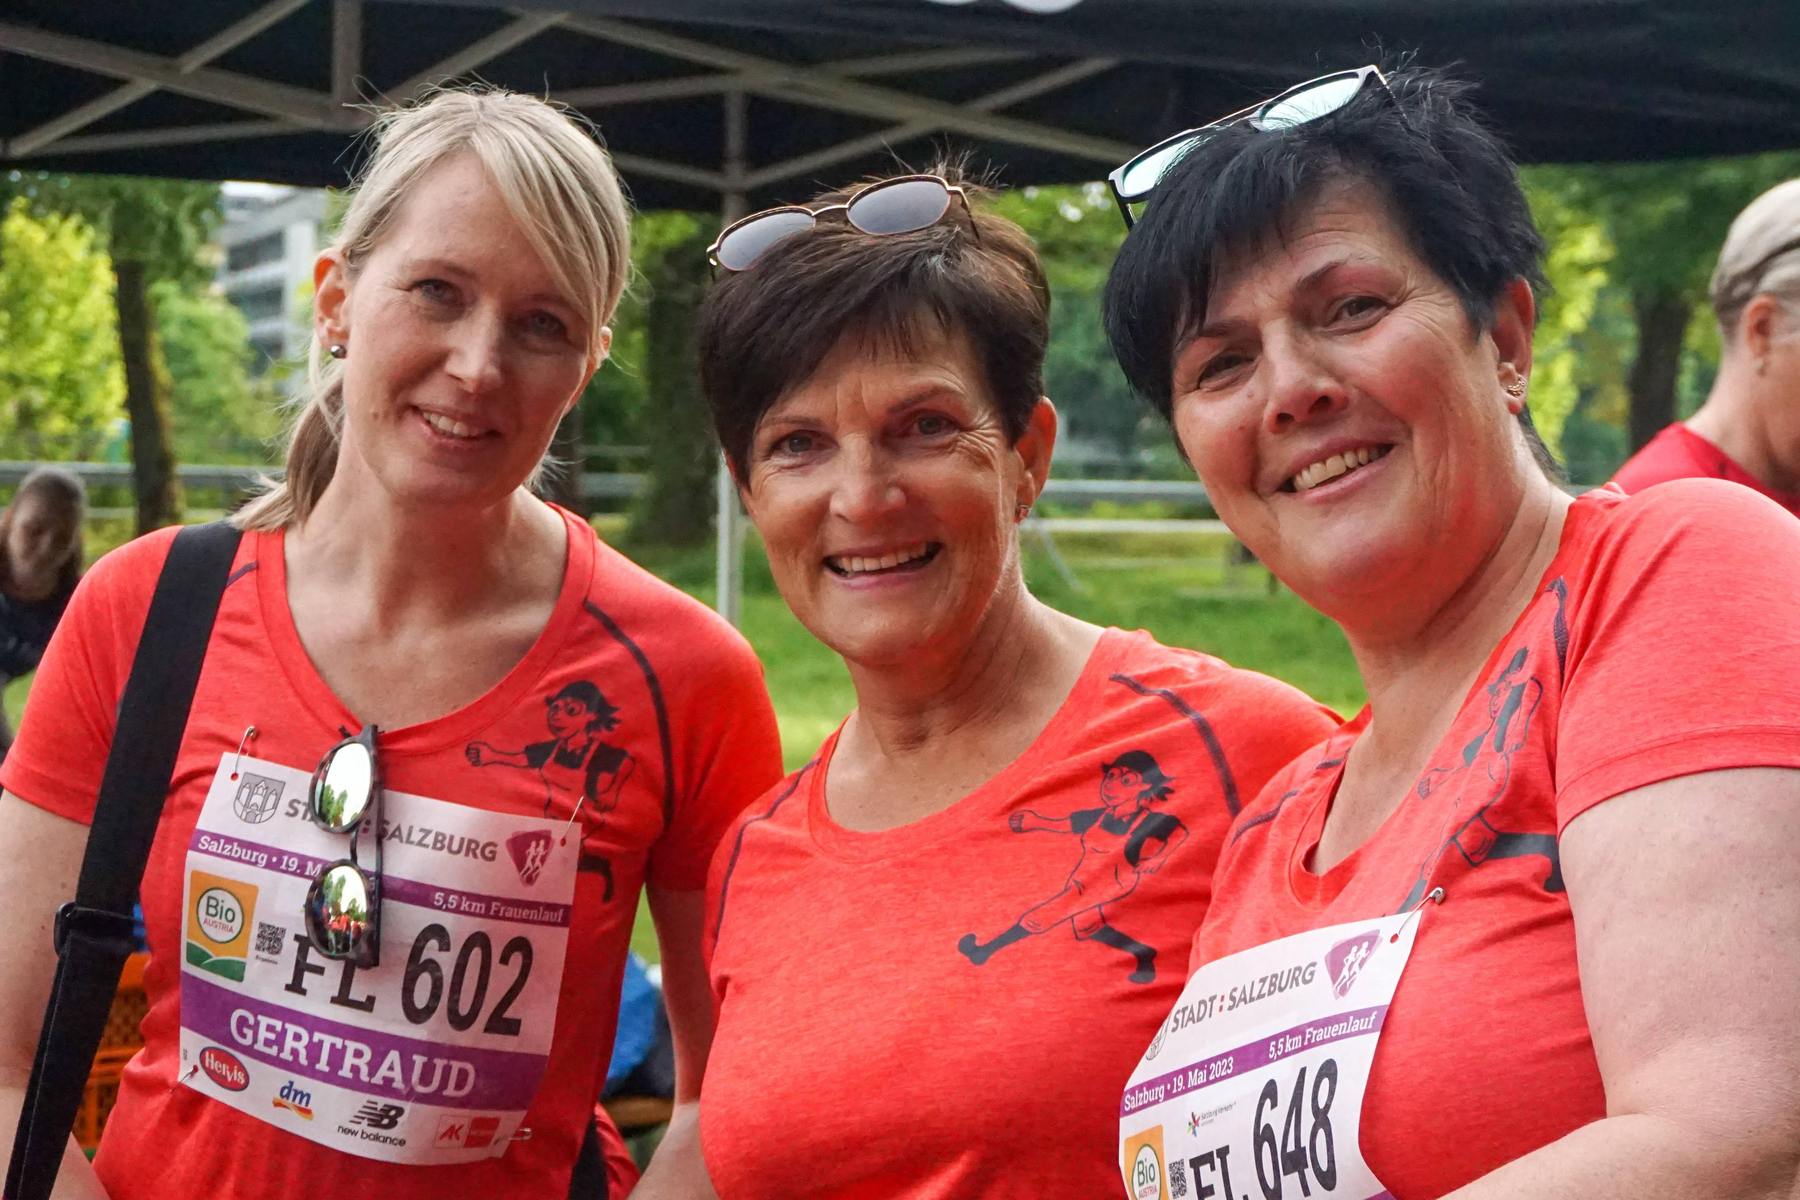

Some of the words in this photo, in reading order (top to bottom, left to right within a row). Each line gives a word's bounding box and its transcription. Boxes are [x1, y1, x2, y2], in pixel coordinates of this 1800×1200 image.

[198, 835, 268, 867] Salzburg
[279, 855, 301, 873] 19.
[205, 896, 236, 923] Bio
[433, 891, 458, 910] 5,5
[460, 895, 486, 914] km
[489, 901, 565, 923] Frauenlauf
[203, 917, 235, 933] AUSTRIA
[284, 933, 376, 1013] FL
[401, 922, 533, 1037] 602
[1171, 994, 1217, 1033] STADT
[1227, 961, 1317, 1012] SALZBURG
[1268, 1038, 1284, 1060] 5,5
[1285, 1034, 1302, 1053] km
[1303, 1010, 1378, 1046] Frauenlauf
[205, 1052, 246, 1085] Hervis
[230, 1008, 475, 1098] GERTRAUD
[279, 1081, 312, 1107] dm
[1124, 1084, 1165, 1112] Salzburg
[1172, 1074, 1186, 1094] 19.
[1188, 1064, 1208, 1088] Mai
[1209, 1056, 1234, 1081] 2023
[337, 1125, 359, 1137] new
[361, 1129, 406, 1147] balance
[1253, 1058, 1338, 1200] 648
[1137, 1158, 1156, 1186] Bio
[1139, 1184, 1158, 1199] AUSTRIA
